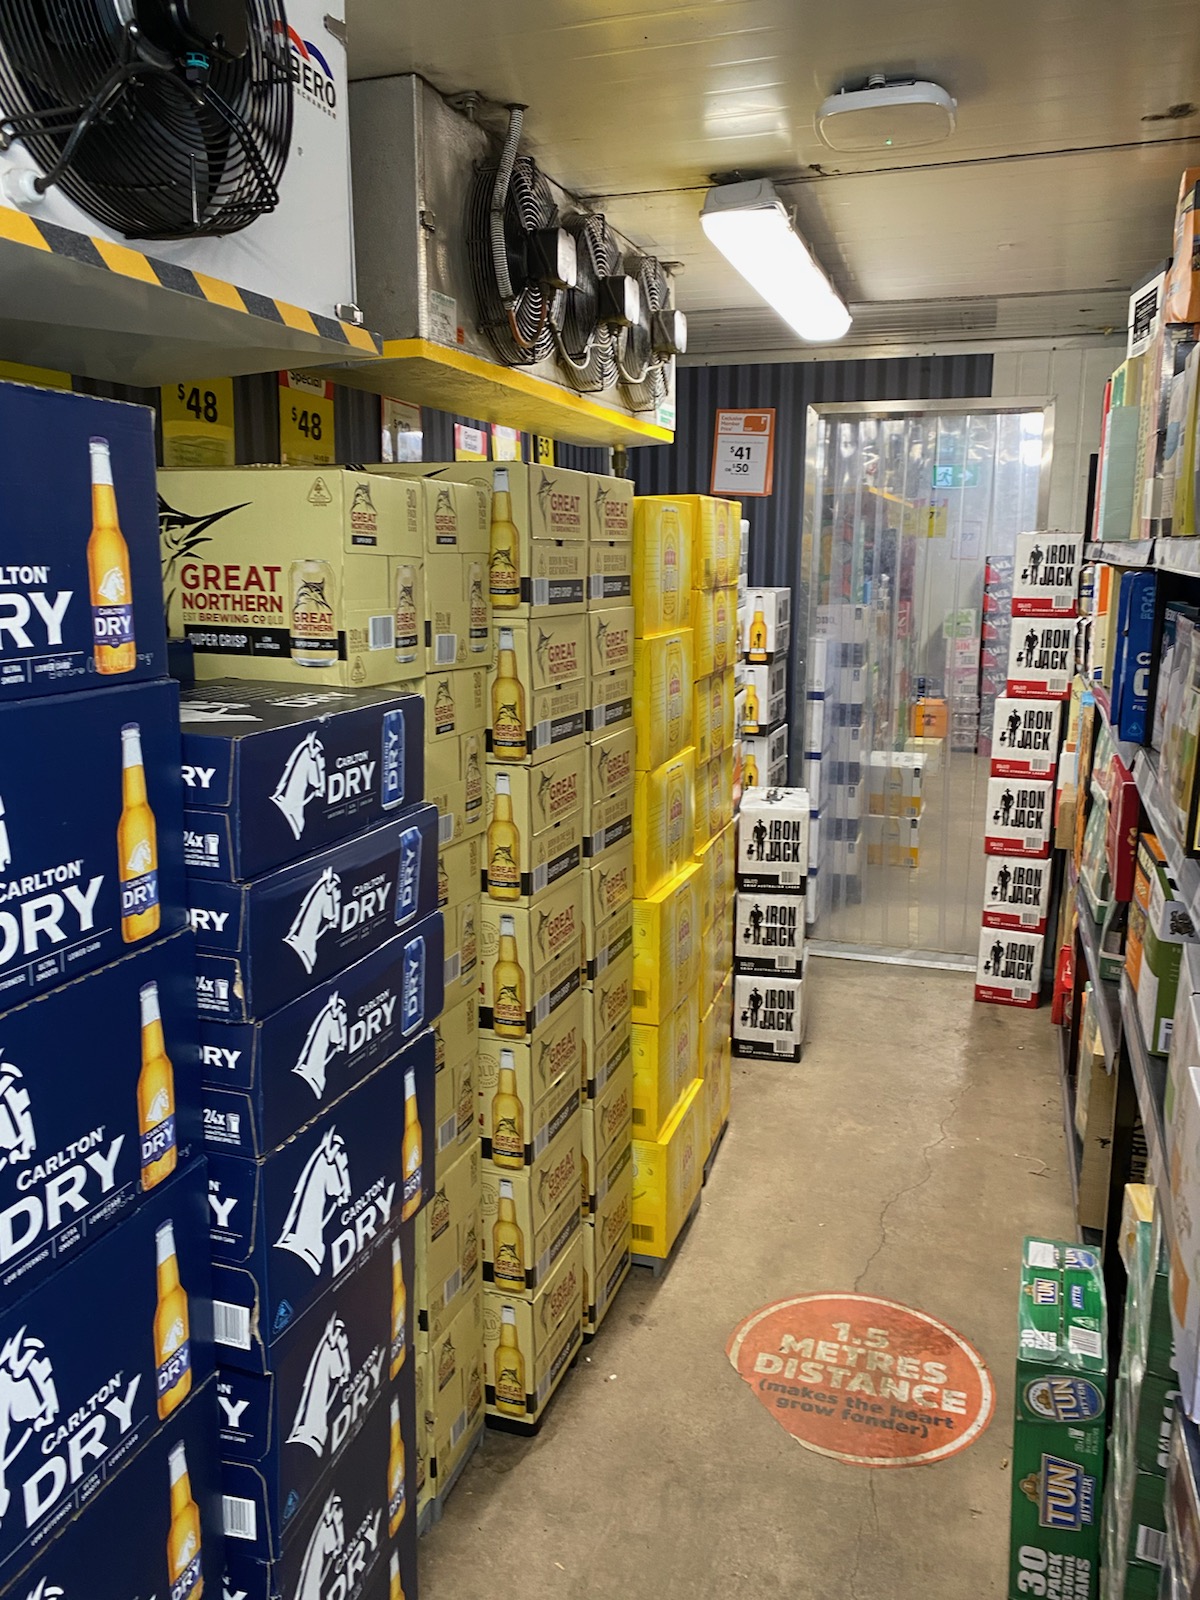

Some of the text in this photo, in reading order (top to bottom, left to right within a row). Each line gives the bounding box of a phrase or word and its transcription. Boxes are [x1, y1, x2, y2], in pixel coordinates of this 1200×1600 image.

[177, 383, 218, 424] $48
[291, 406, 323, 441] $48
[730, 446, 752, 460] $41
[732, 463, 749, 473] $50
[551, 493, 580, 513] GREAT
[605, 500, 628, 517] GREAT
[351, 511, 377, 524] GREAT
[351, 523, 377, 532] NORTHERN
[434, 515, 456, 525] GREAT
[434, 524, 457, 532] NORTHERN
[551, 512, 580, 525] NORTHERN
[1045, 544, 1076, 565] IRON
[181, 563, 282, 592] GREAT
[490, 570, 517, 580] GREAT
[1039, 566, 1073, 587] JACK
[181, 592, 284, 613] NORTHERN
[471, 607, 487, 617] GREAT
[94, 615, 133, 637] DRY
[183, 612, 197, 622] EST
[199, 612, 249, 624] BREWING
[293, 612, 333, 624] GREAT
[293, 624, 334, 633] NORTHERN
[396, 612, 416, 623] GREAT
[188, 633, 248, 648] SUPER CRISP
[605, 629, 629, 648] GREAT
[1040, 629, 1071, 649] IRON
[548, 642, 576, 662] GREAT
[1034, 650, 1068, 670] JACK
[434, 703, 454, 717] GREAT
[1023, 710, 1053, 730] IRON
[495, 723, 521, 732] GREAT
[1018, 730, 1050, 750] JACK
[335, 751, 369, 769] CARLTON
[387, 730, 399, 791] DRY
[607, 750, 630, 774] GREAT
[327, 761, 376, 805] DRY
[550, 773, 577, 800] GREAT
[1016, 789, 1046, 809] IRON
[1011, 809, 1044, 829] JACK
[768, 820, 801, 841] IRON
[765, 841, 801, 863] JACK
[401, 849, 415, 908] DRY
[490, 864, 517, 874] GREAT
[1012, 866, 1043, 887] IRON
[123, 879, 157, 909] DRY
[351, 873, 386, 898] CARLTON
[1008, 884, 1041, 906] JACK
[340, 882, 392, 934] DRY
[765, 905, 797, 927] IRON
[187, 908, 229, 932] RY
[548, 904, 575, 936] GREAT
[762, 926, 797, 947] JACK
[1005, 942, 1035, 963] IRON
[1001, 960, 1034, 981] JACK
[196, 976, 214, 992] 4x
[407, 959, 419, 1018] DRY
[358, 989, 391, 1018] CARLTON
[496, 1003, 522, 1012] GREAT
[765, 989, 795, 1010] IRON
[349, 995, 397, 1055] DRY
[759, 1009, 794, 1032] JACK
[550, 1027, 576, 1064] GREAT
[199, 1045, 242, 1070] RY
[203, 1108, 226, 1126] 24x
[142, 1124, 174, 1159] DRY
[496, 1134, 520, 1144] GREAT
[16, 1128, 104, 1192] CARLTON
[0, 1134, 125, 1264] DRY
[340, 1176, 385, 1226] CARLTON
[331, 1182, 396, 1279] DRY
[496, 1259, 521, 1268] GREAT
[1037, 1279, 1054, 1304] TUN
[1071, 1285, 1083, 1309] BITTER
[832, 1322, 889, 1349] 1.5
[1020, 1329, 1034, 1348] 30
[157, 1349, 190, 1392] DRY
[778, 1334, 948, 1385] METRES
[341, 1344, 379, 1403] CARLTON
[753, 1352, 967, 1415] DISTANCE
[331, 1346, 387, 1454] DRY
[758, 1378, 954, 1430] (makes the heart
[1051, 1378, 1080, 1421] TUN
[1078, 1382, 1092, 1417] BITTER
[41, 1373, 121, 1455] CARLTON
[776, 1397, 929, 1439] grow fonder)
[22, 1373, 142, 1529] DRY
[1047, 1463, 1078, 1523] TUN
[1080, 1476, 1094, 1524] BITTER
[334, 1508, 374, 1574] CARLTON
[326, 1507, 382, 1600] DRY
[1017, 1545, 1048, 1597] 30
[1046, 1551, 1064, 1600] PACK
